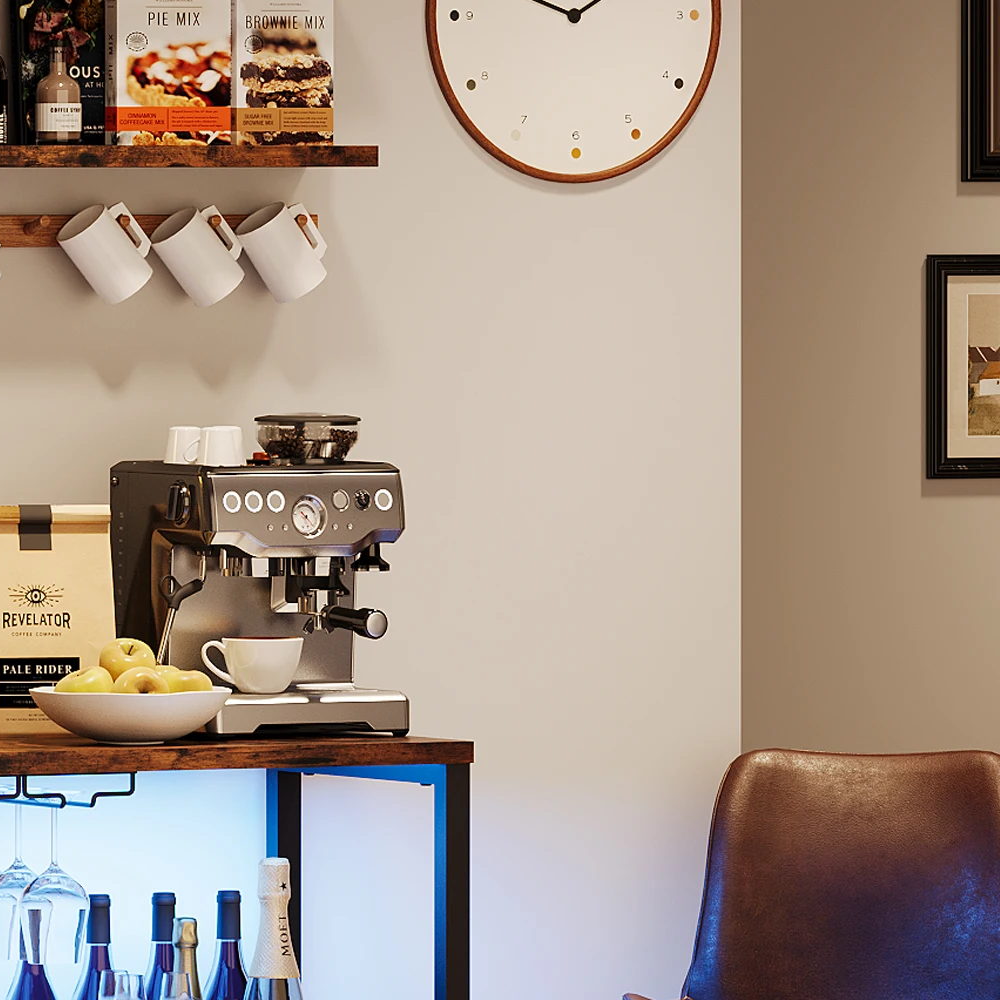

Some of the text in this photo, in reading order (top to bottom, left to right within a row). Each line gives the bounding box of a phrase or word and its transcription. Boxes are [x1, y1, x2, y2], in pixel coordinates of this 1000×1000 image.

[148, 12, 200, 26] PIE MIX
[465, 11, 474, 20] 9
[676, 10, 684, 20] 3
[245, 15, 325, 29] BROWNIE MIX
[481, 70, 488, 80] 8
[662, 70, 669, 79] 4
[520, 114, 528, 124] 7
[624, 114, 632, 123] 5
[572, 130, 580, 140] 6
[2, 611, 71, 630] REVELATOR
[3, 664, 73, 674] PALE RIDER
